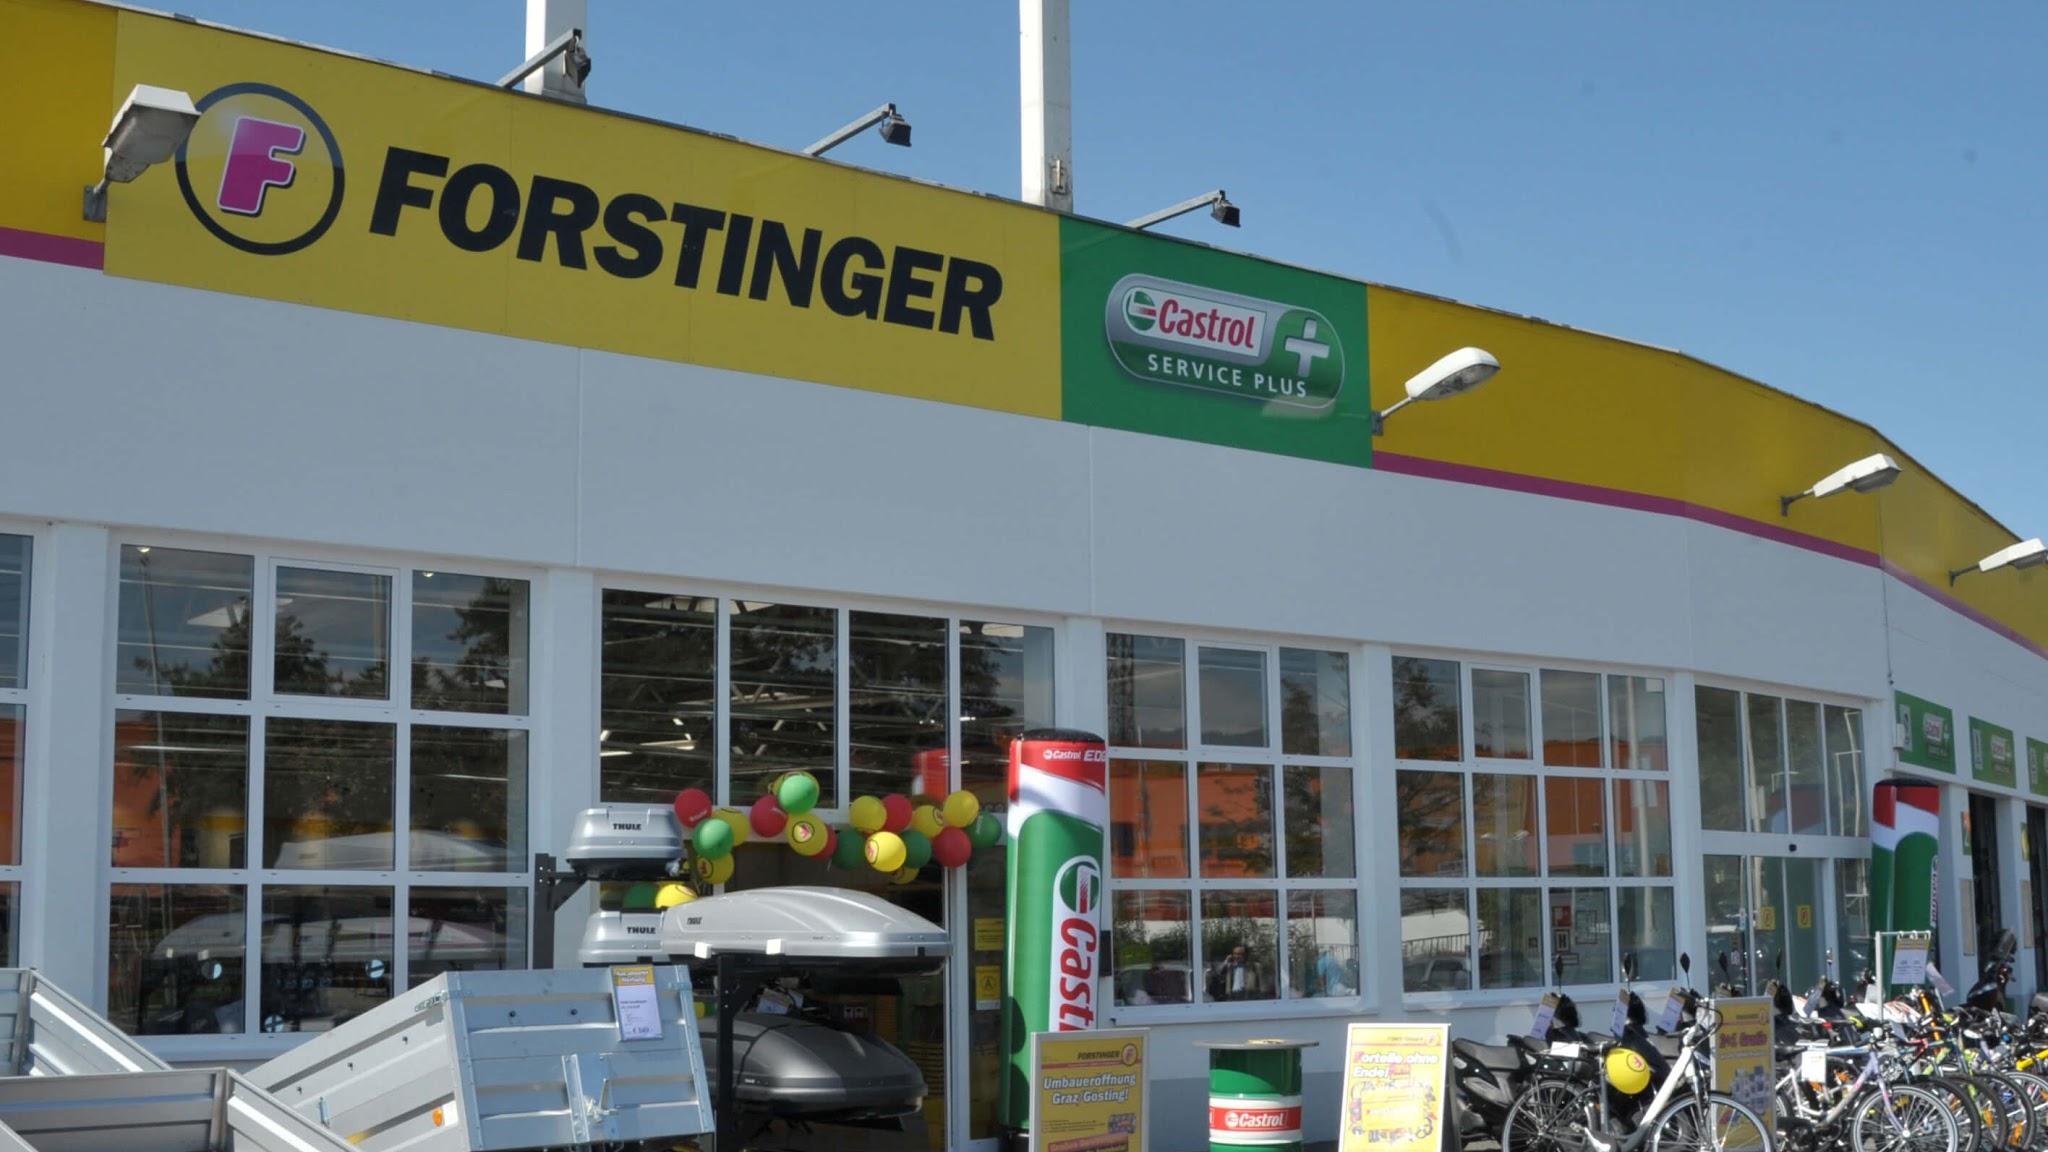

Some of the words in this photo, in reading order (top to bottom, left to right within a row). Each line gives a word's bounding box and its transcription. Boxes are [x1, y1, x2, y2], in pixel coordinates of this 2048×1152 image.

[217, 115, 304, 218] F
[369, 146, 1004, 341] FORSTINGER
[1158, 299, 1255, 349] Castrol
[1147, 354, 1243, 387] SERVICE
[1254, 373, 1307, 398] PLUS
[613, 823, 642, 831] THULE
[627, 926, 656, 935] THULE
[1052, 1092, 1080, 1105] Graz
[1239, 1112, 1285, 1128] Castrol
